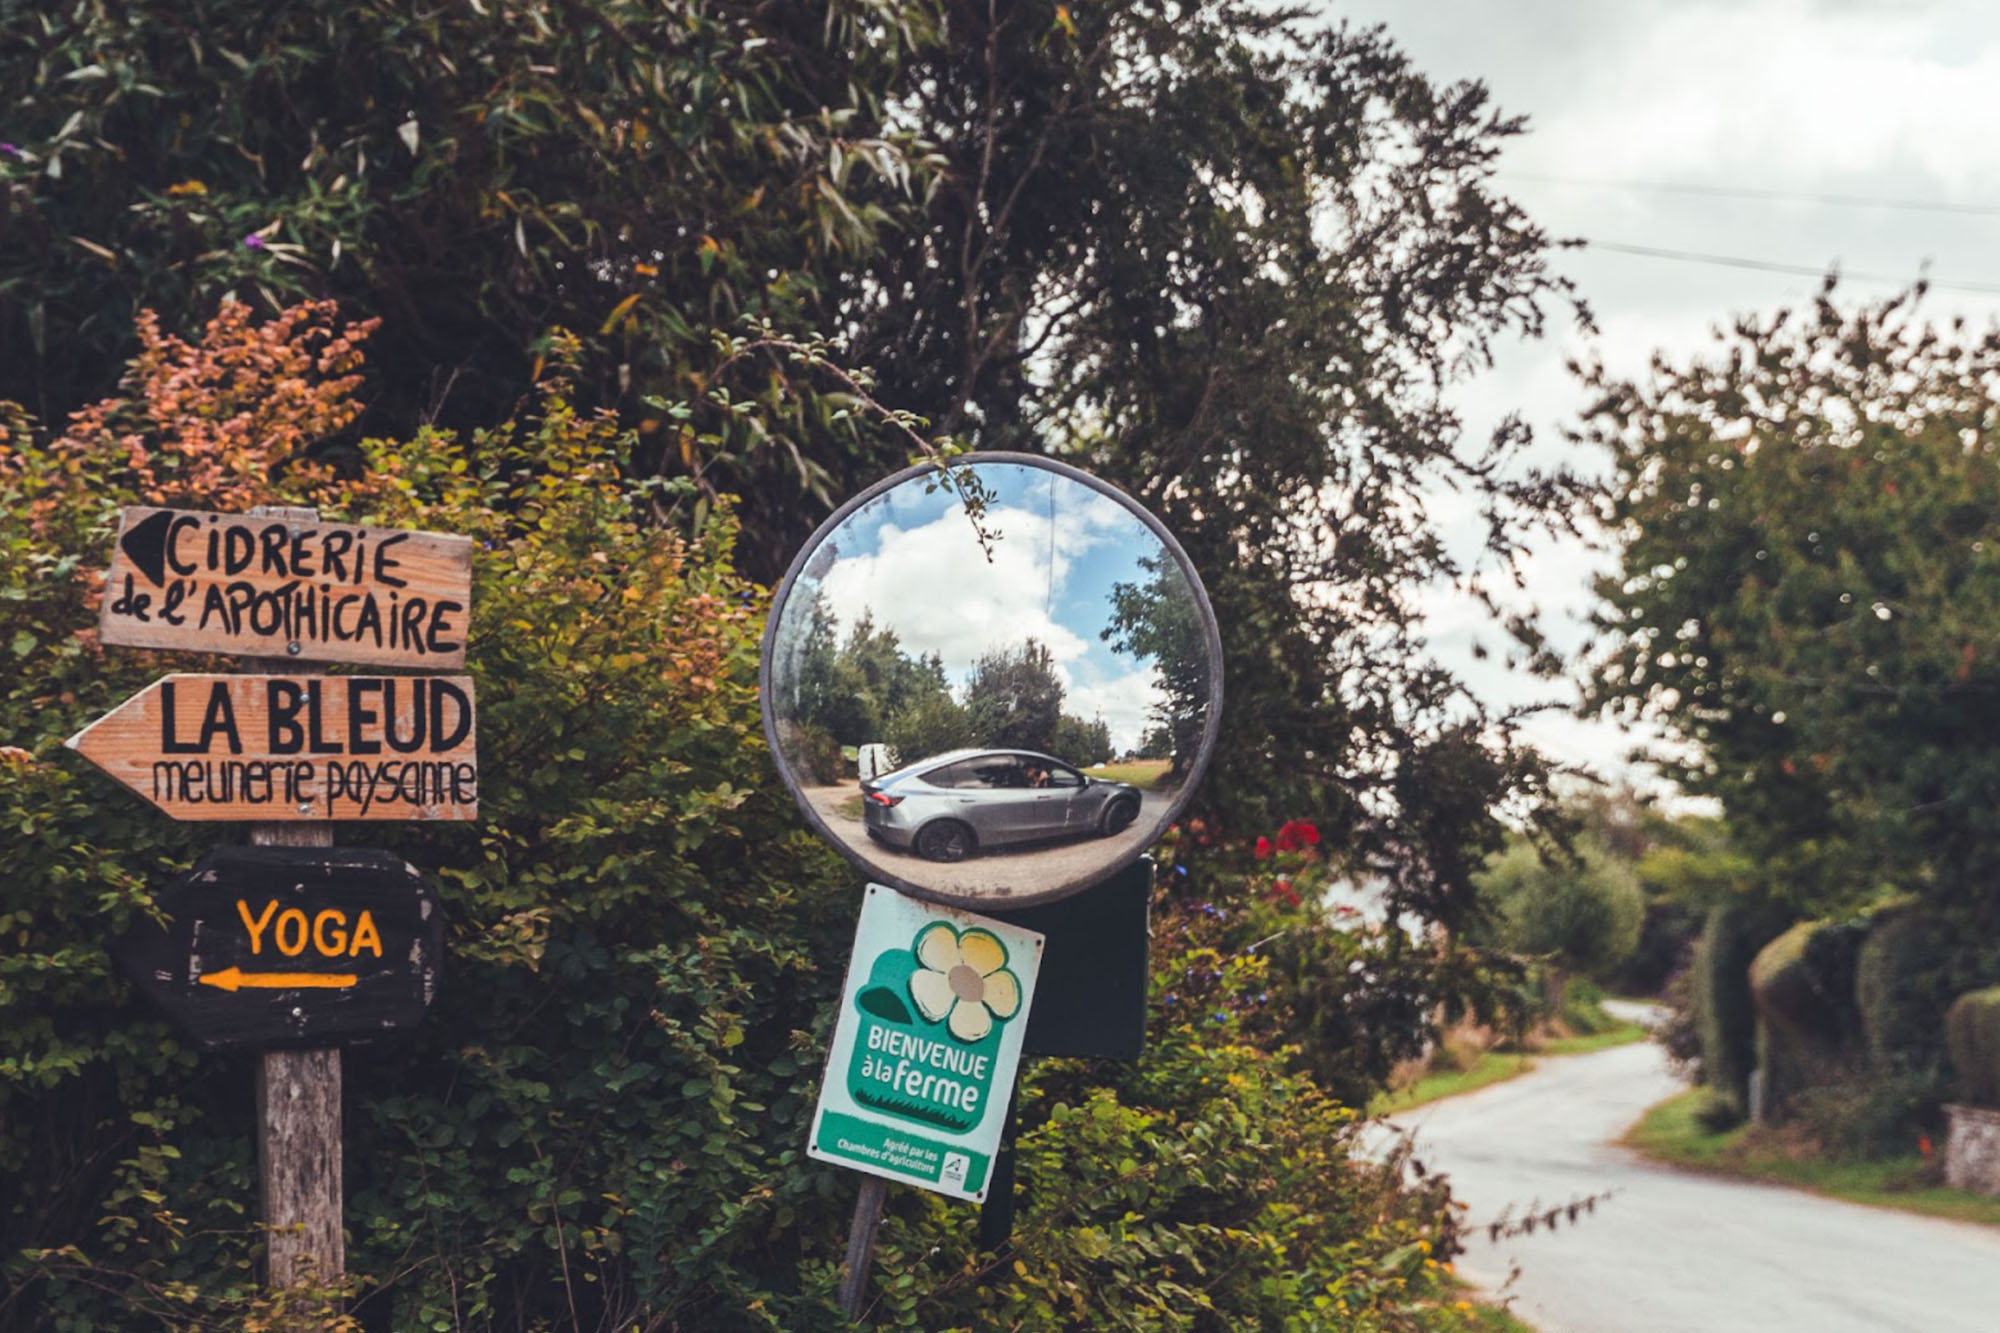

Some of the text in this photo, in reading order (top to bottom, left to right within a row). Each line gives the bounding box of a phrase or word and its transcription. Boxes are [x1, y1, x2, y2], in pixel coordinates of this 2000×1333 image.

[111, 572, 151, 622] de
[161, 679, 472, 754] LA BLEUD
[153, 760, 477, 817] meunerie paysanne
[237, 899, 382, 957] YOGA
[868, 1025, 989, 1080] BIENVENUE
[861, 1054, 874, 1077] à
[893, 1059, 979, 1112] ferme
[837, 1138, 935, 1174] Chambres d'agriculture
[909, 1146, 925, 1158] par
[924, 1149, 938, 1162] les
